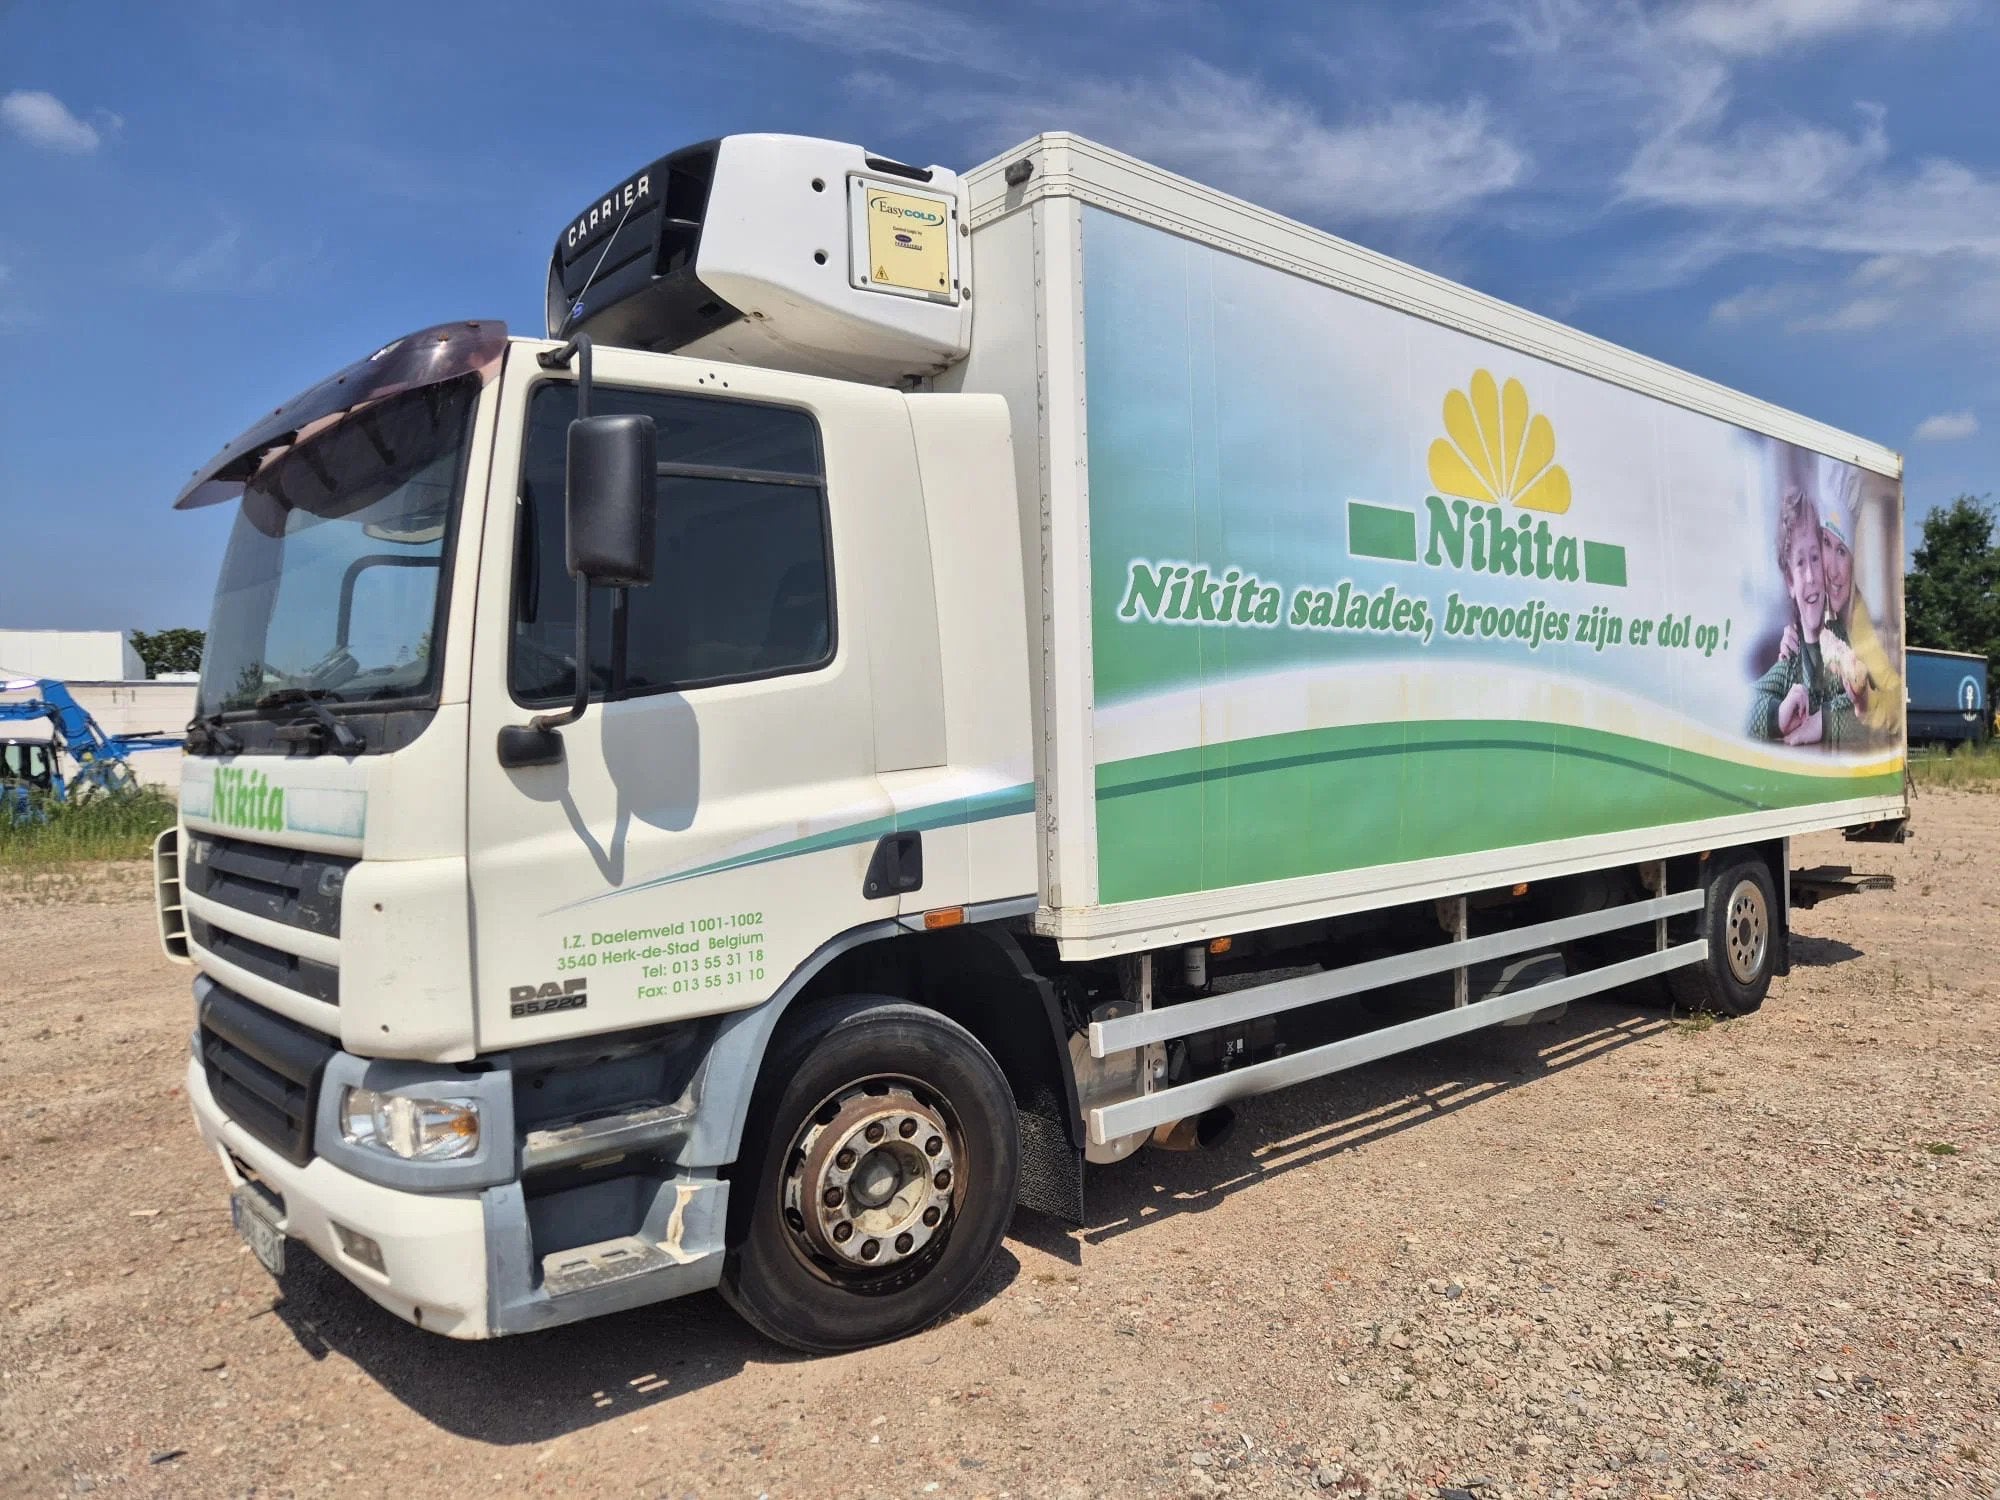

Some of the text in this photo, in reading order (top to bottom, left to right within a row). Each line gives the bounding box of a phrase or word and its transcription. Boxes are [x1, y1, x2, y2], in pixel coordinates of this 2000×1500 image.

[568, 174, 649, 248] CARRIER
[879, 200, 937, 221] EasyCOLD
[1424, 495, 1580, 583] Nikita
[1120, 564, 1280, 624] Nikita
[1290, 582, 1433, 644] salades,
[1444, 592, 1570, 649] broodjes
[1575, 605, 1623, 652] zijn
[1629, 618, 1654, 646] er
[1658, 612, 1692, 648] dol
[211, 766, 284, 833] Nikita
[591, 921, 685, 946] Daelemveld
[690, 911, 763, 933] 1001-1002
[557, 933, 764, 971] 3540 Herk-de-Stad Belgium
[641, 949, 764, 979] Tel: 013 55 31 18
[510, 977, 587, 1003] DAF
[637, 967, 764, 999] Fax: 013 55 31 10
